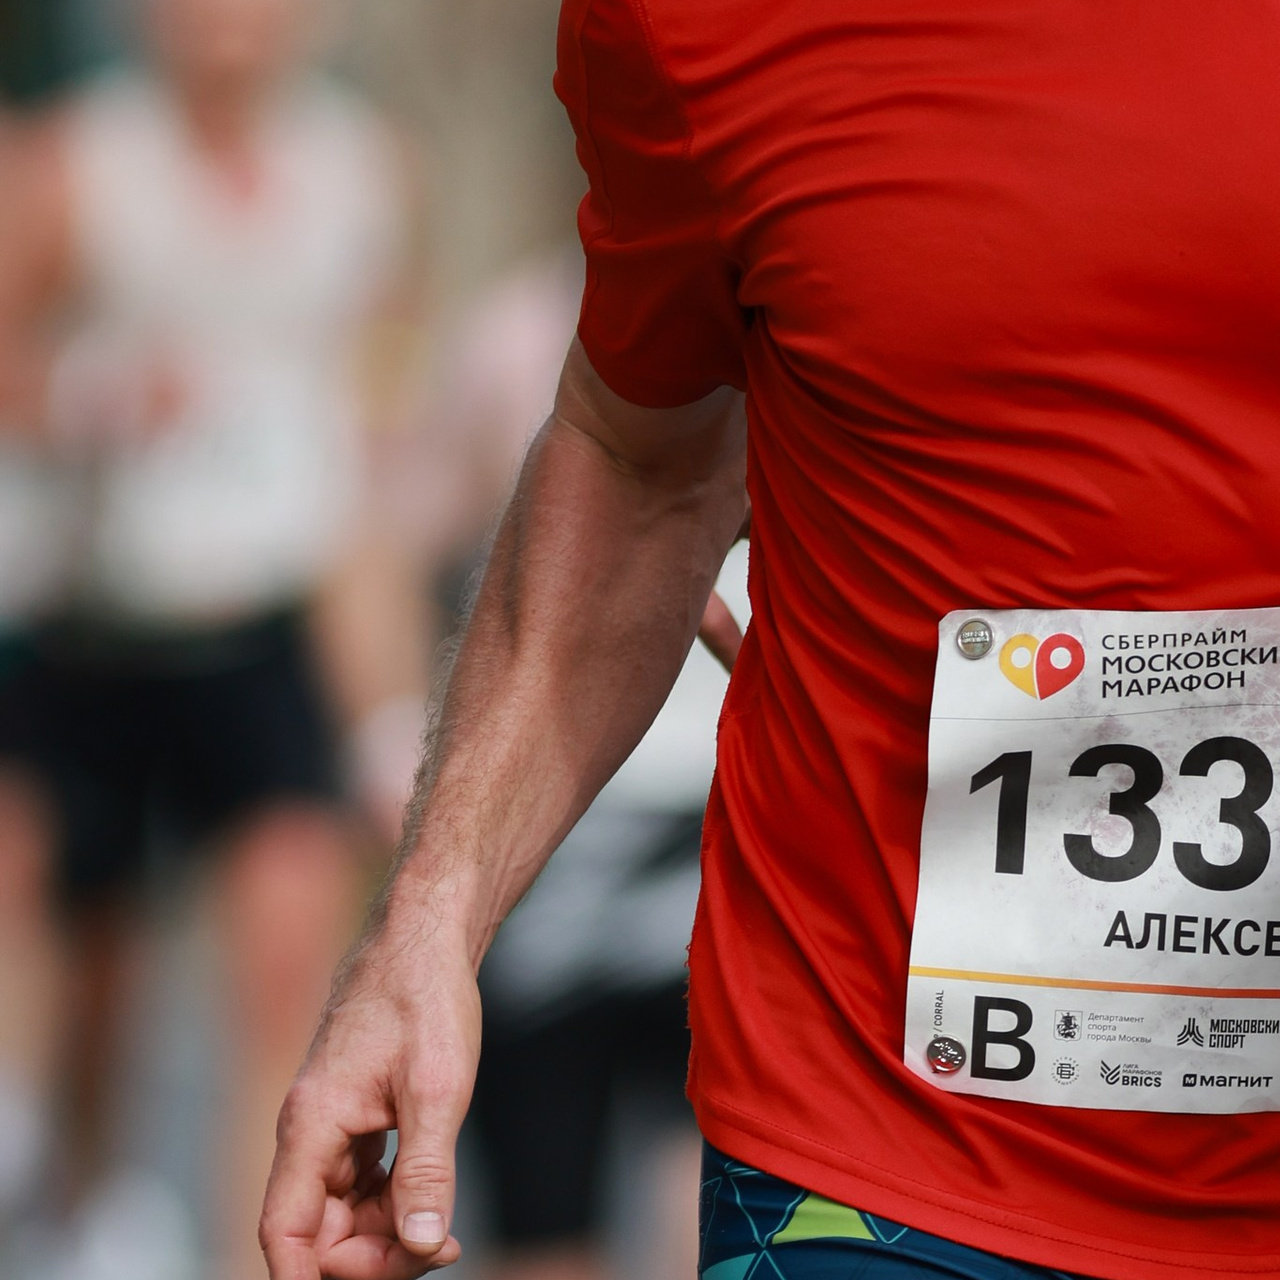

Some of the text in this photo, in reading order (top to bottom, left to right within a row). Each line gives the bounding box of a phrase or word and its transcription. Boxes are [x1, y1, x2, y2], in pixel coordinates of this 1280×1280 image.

[1101, 628, 1248, 652] СБЕРПРАЙМ
[1101, 670, 1246, 700] МАРАФОН
[933, 989, 944, 1027] CORRAL
[1088, 1012, 1145, 1024] Департамент
[1087, 1023, 1117, 1033] спорта
[1087, 1033, 1152, 1044] города Москвы
[1208, 1034, 1246, 1049] СПОРТ
[1121, 1075, 1162, 1088] BRICS
